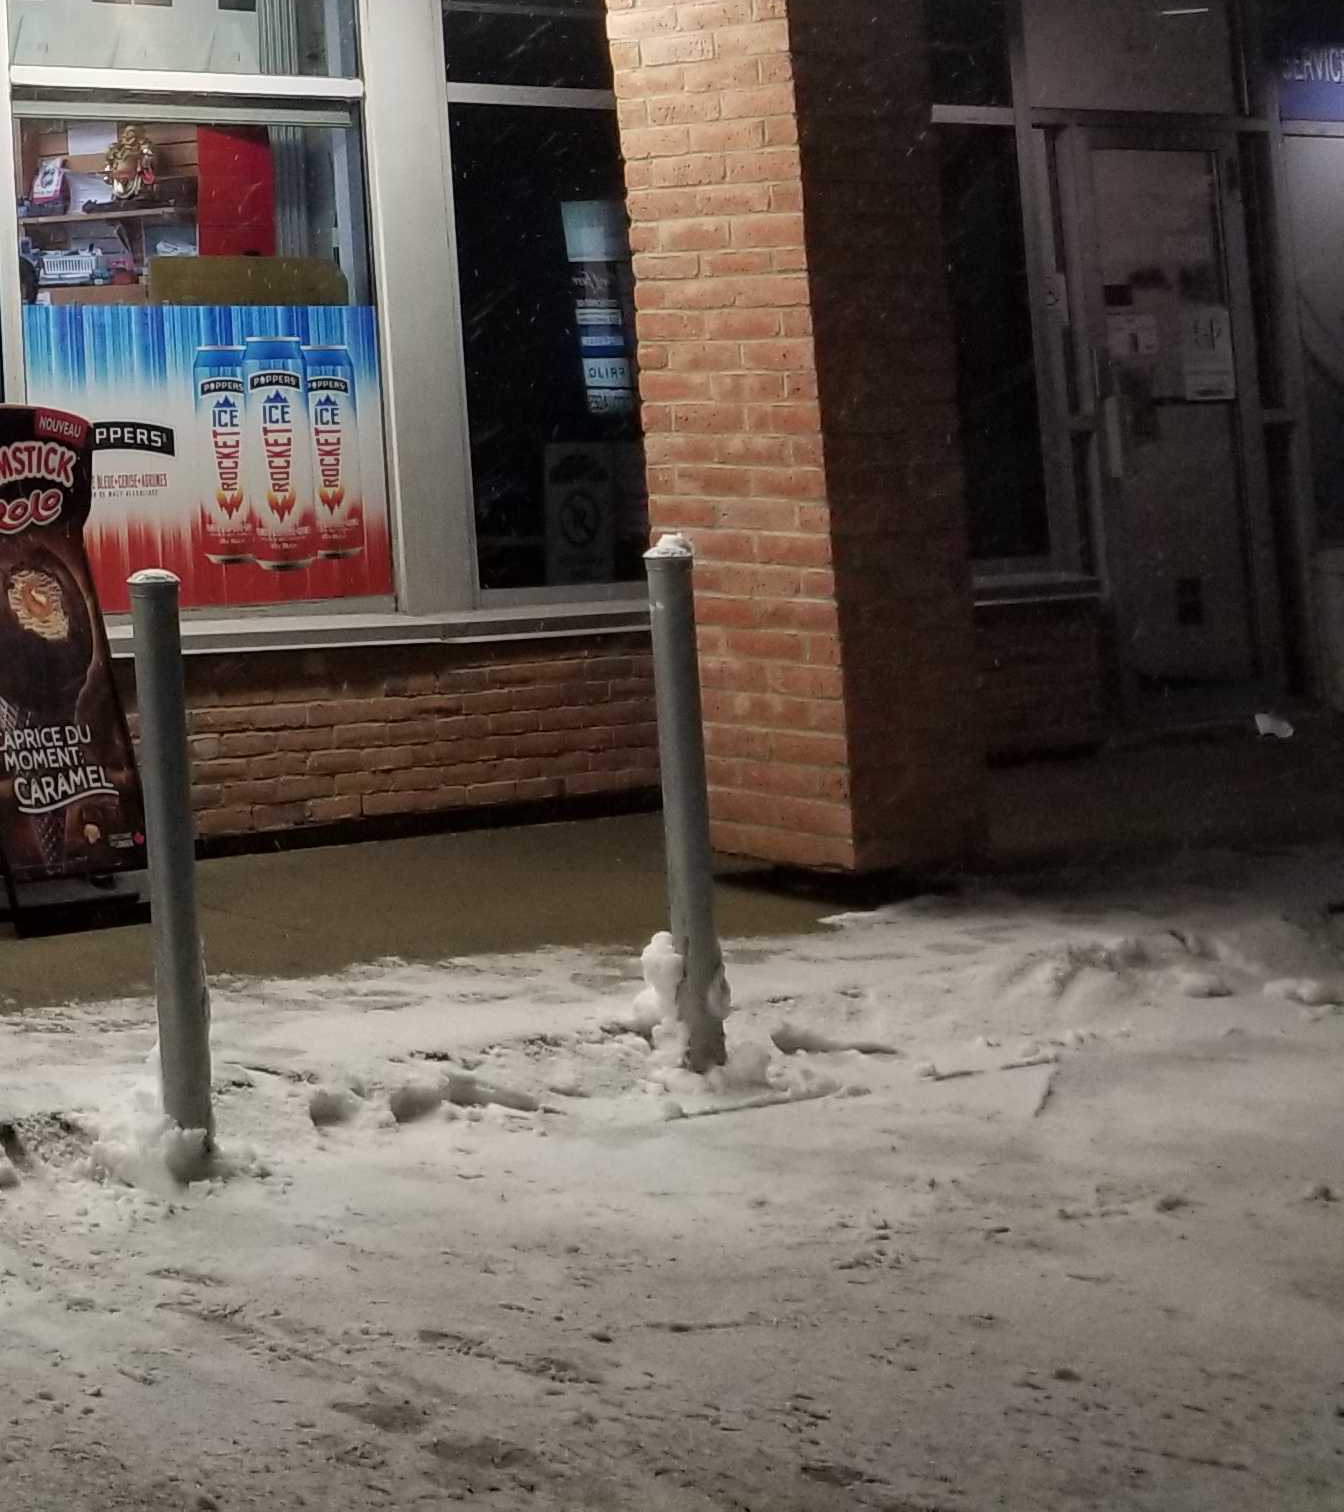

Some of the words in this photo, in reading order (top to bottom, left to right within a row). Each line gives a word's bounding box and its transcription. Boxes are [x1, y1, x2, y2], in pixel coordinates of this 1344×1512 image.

[202, 380, 244, 392] POPPERS
[253, 374, 296, 386] POPPERS
[212, 409, 239, 427] ICE
[263, 405, 291, 424] ICE
[315, 408, 340, 426] ICE
[40, 416, 81, 438] NOUVEAU
[212, 429, 240, 491] ROCKET
[263, 426, 292, 492] ROCKET
[315, 427, 341, 488] ROCKET
[65, 725, 91, 744] DU
[4, 746, 85, 772] MOMENT:
[14, 766, 115, 805] CARAMEL
